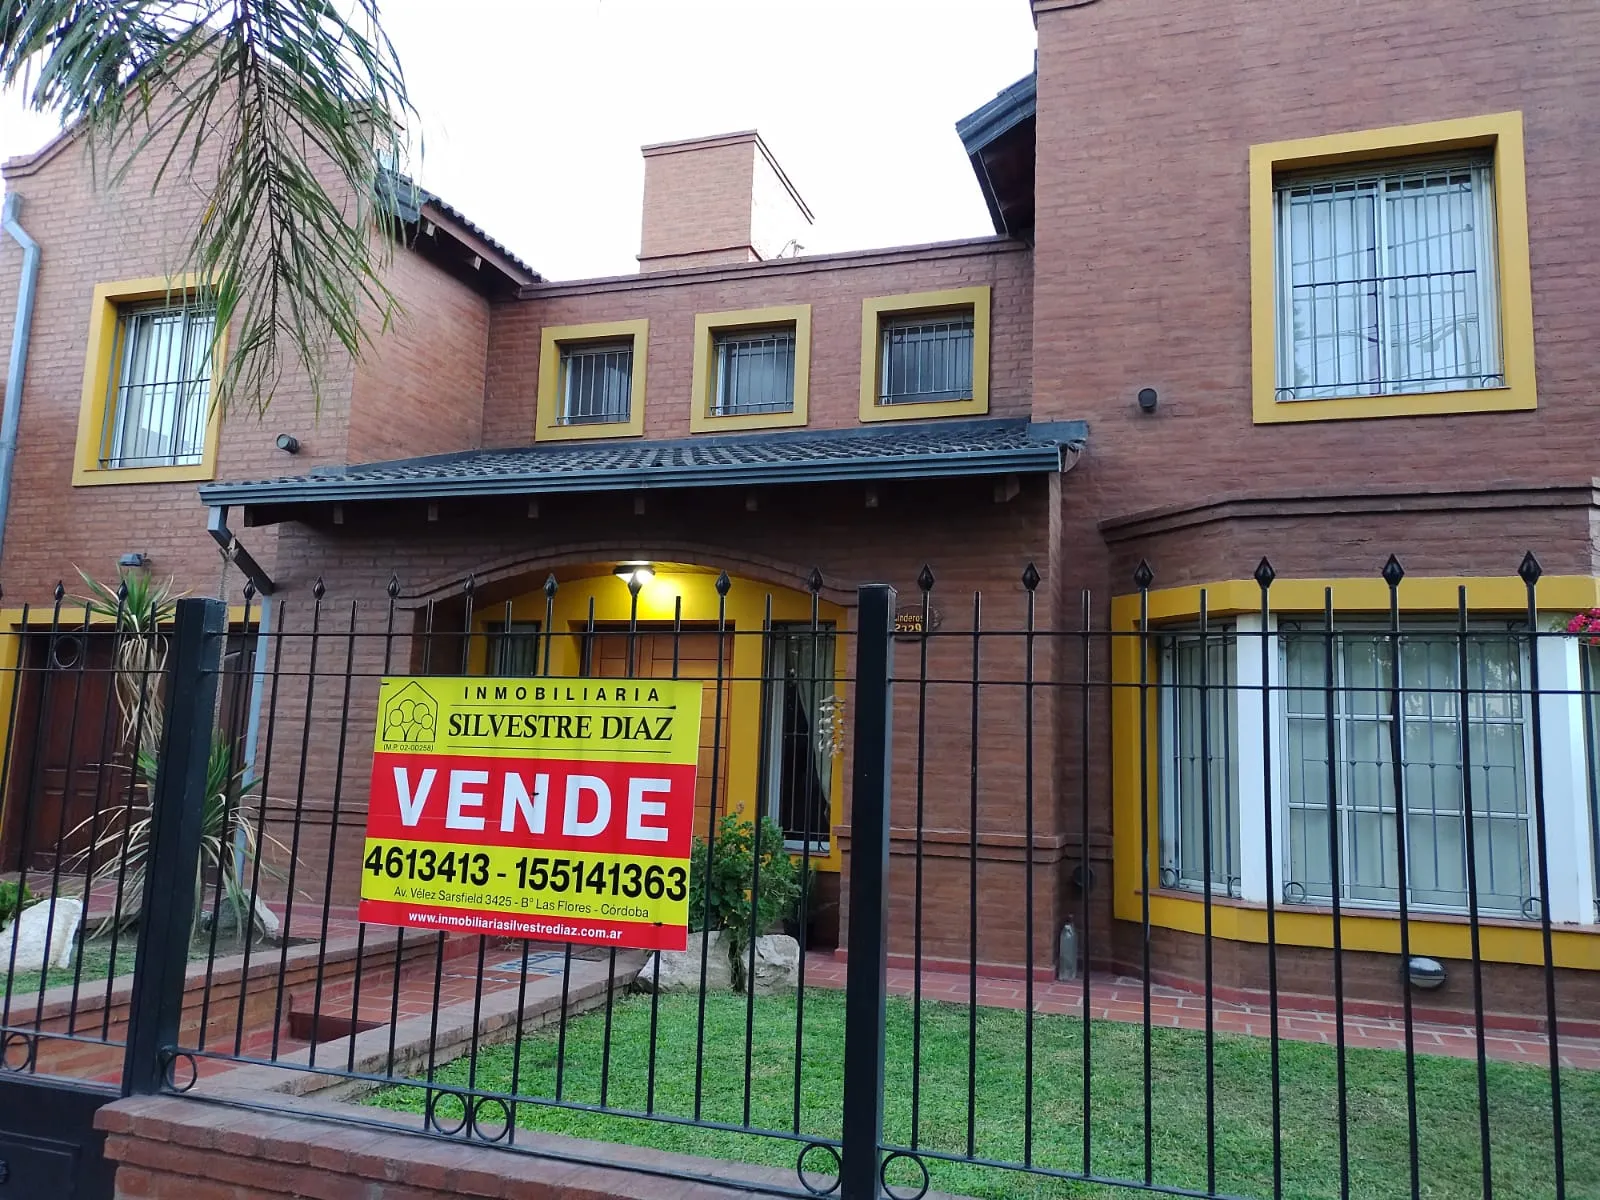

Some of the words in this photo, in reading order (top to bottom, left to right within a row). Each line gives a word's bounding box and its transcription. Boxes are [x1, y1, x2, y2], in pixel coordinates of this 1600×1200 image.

[464, 686, 659, 702] INMOBILIARIA
[448, 713, 592, 739] SILVESTRE
[601, 716, 673, 741] DIAZ
[392, 766, 672, 842] VENDE
[364, 845, 490, 886] 4613413
[515, 856, 687, 902] 155141363
[394, 886, 408, 898] Av.
[410, 887, 436, 900] Vélez
[438, 889, 483, 904] Sarsfield
[485, 894, 512, 907] 3425
[536, 900, 555, 911] Las
[557, 900, 591, 914] Flores
[600, 903, 649, 918] Córdoba
[408, 912, 623, 940] www.inmobiliariasilvestrediaz.com.ar
